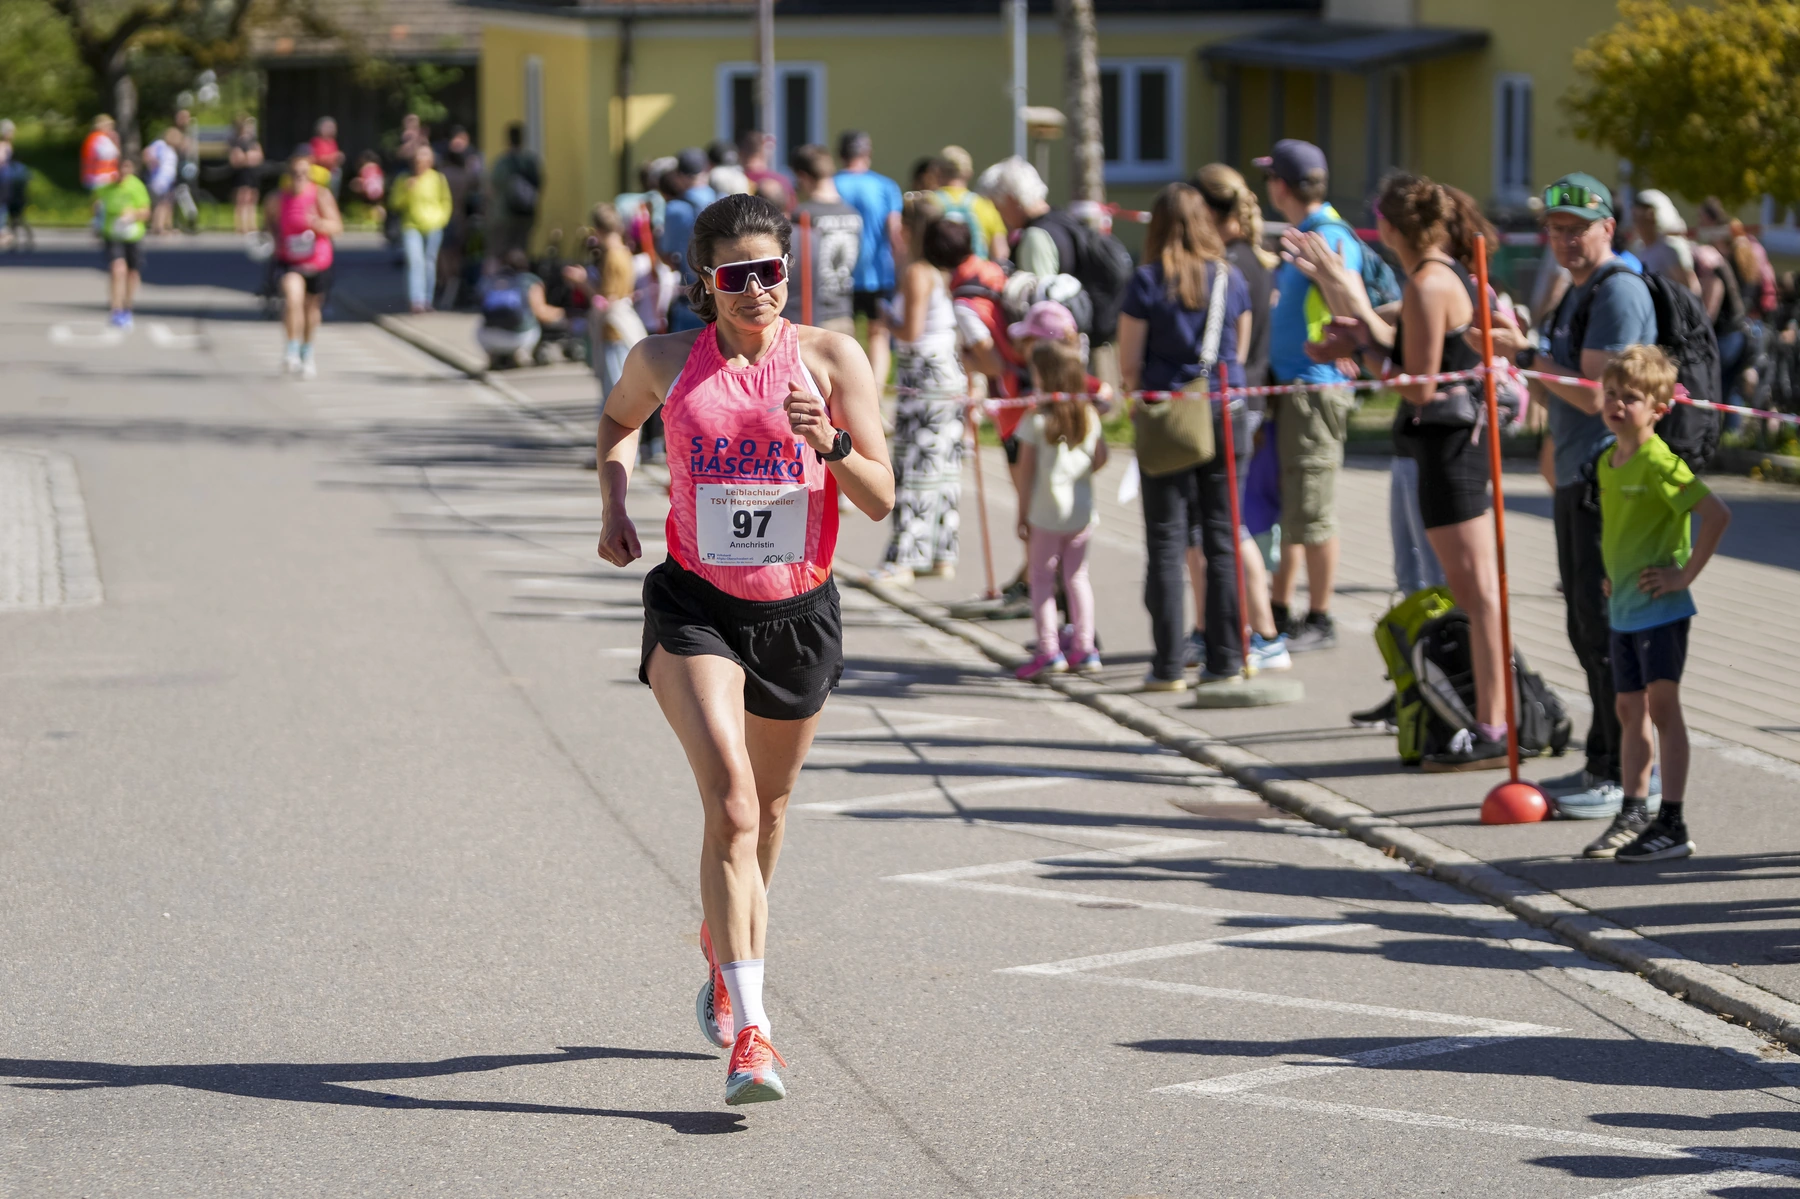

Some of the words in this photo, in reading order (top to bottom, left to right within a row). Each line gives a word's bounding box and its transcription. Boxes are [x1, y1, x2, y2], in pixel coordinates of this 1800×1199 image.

[691, 436, 804, 460] SPORT
[691, 455, 804, 478] HASCHKO
[711, 498, 728, 506] TSV
[730, 498, 794, 507] Hergensweiler
[732, 510, 772, 539] 97
[729, 541, 775, 549] Annchristin
[762, 554, 784, 564] AOK
